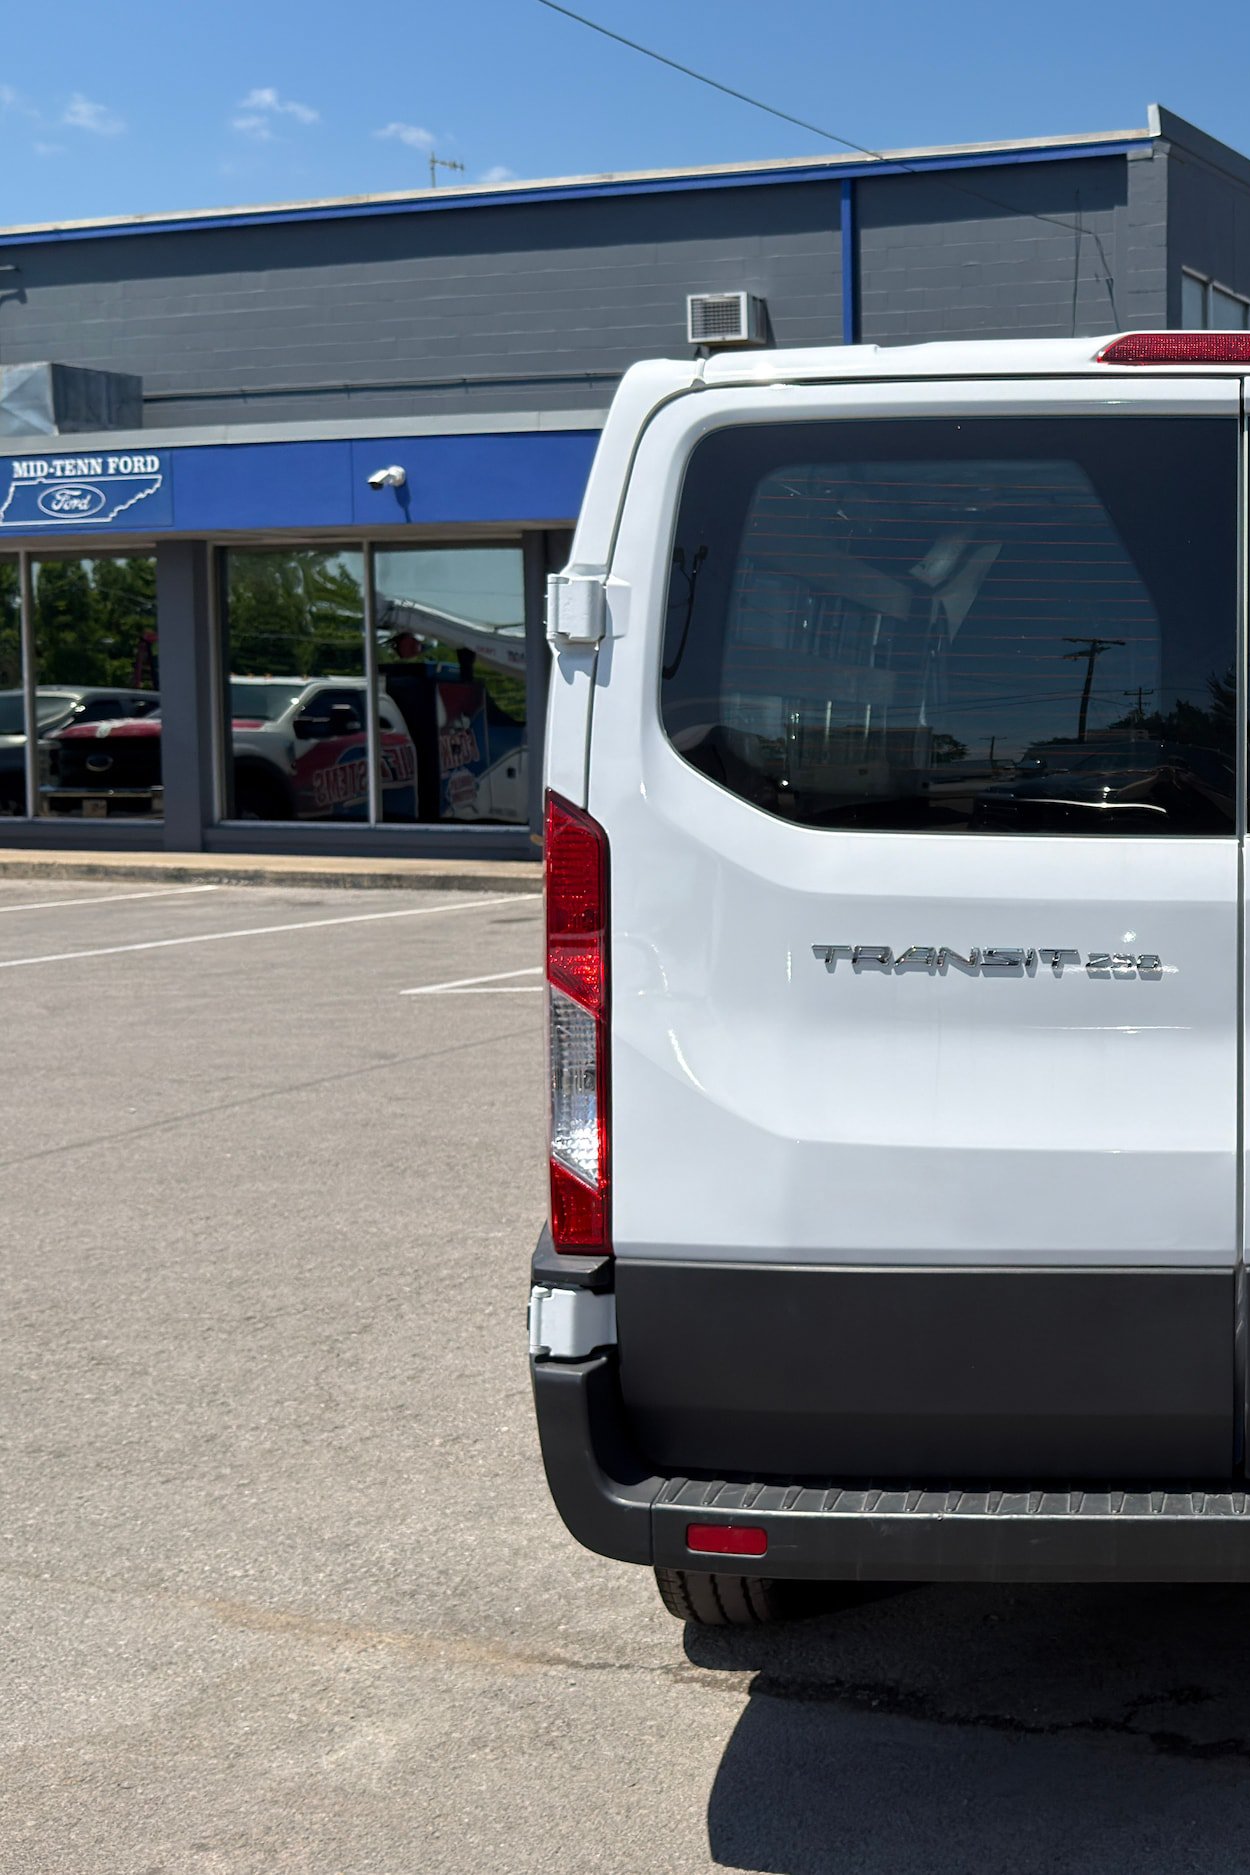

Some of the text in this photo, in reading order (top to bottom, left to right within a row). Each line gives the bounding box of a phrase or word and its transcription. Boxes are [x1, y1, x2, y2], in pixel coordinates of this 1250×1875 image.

[12, 455, 160, 478] MID-TENN FORD
[51, 488, 91, 511] Ford
[812, 944, 1080, 971] TRANSIT
